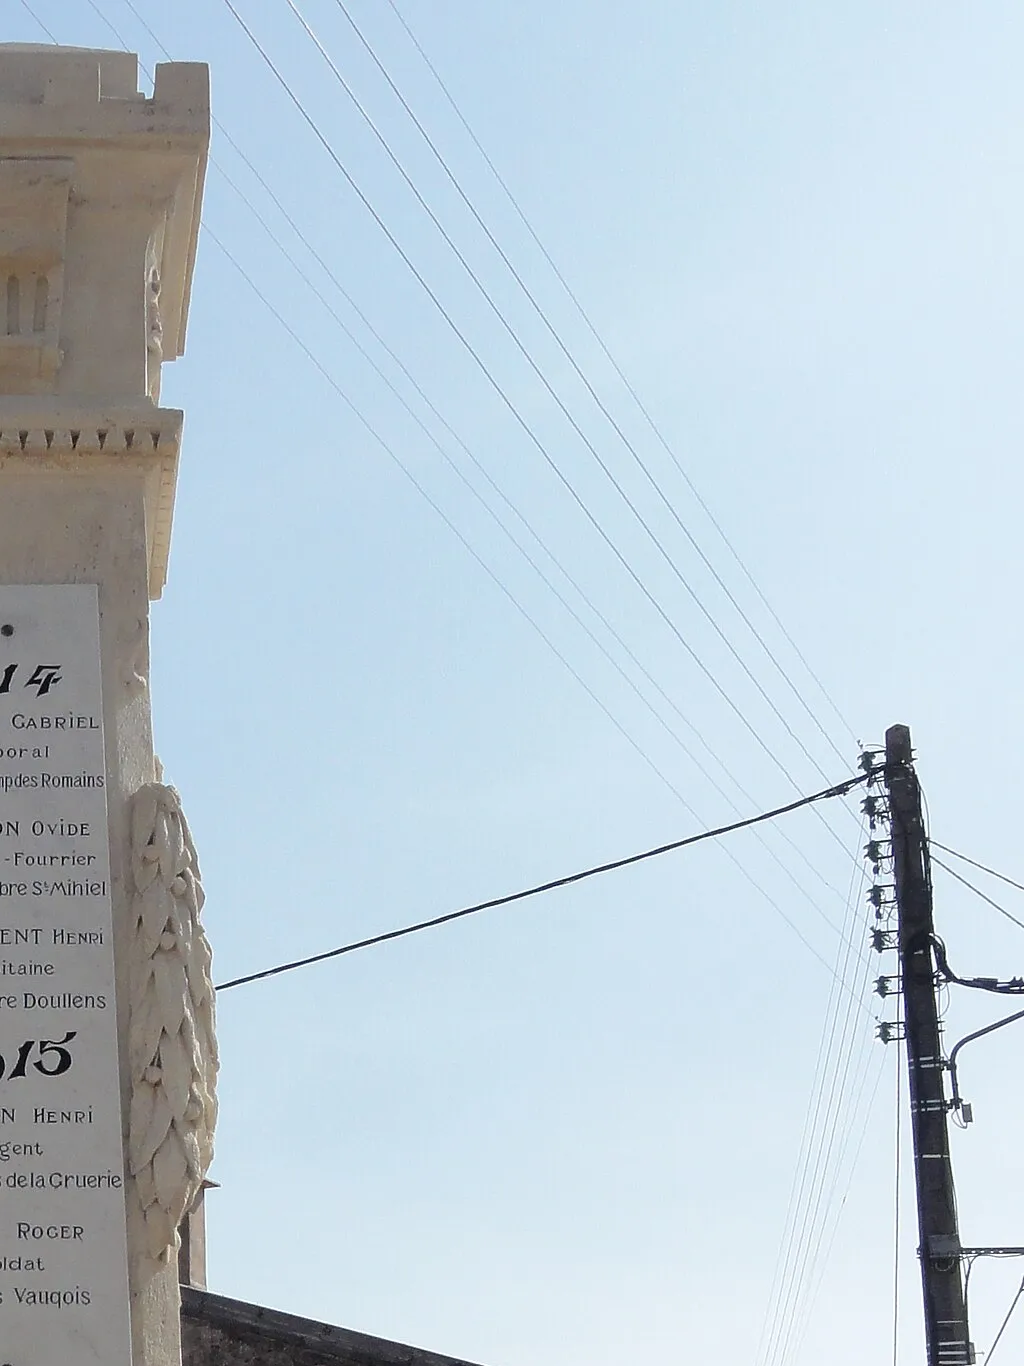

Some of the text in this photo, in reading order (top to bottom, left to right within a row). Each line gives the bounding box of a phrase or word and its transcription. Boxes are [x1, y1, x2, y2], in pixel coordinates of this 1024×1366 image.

[42, 770, 104, 789] Romains
[23, 993, 106, 1010] Doullens
[49, 1170, 123, 1189] Gruerie
